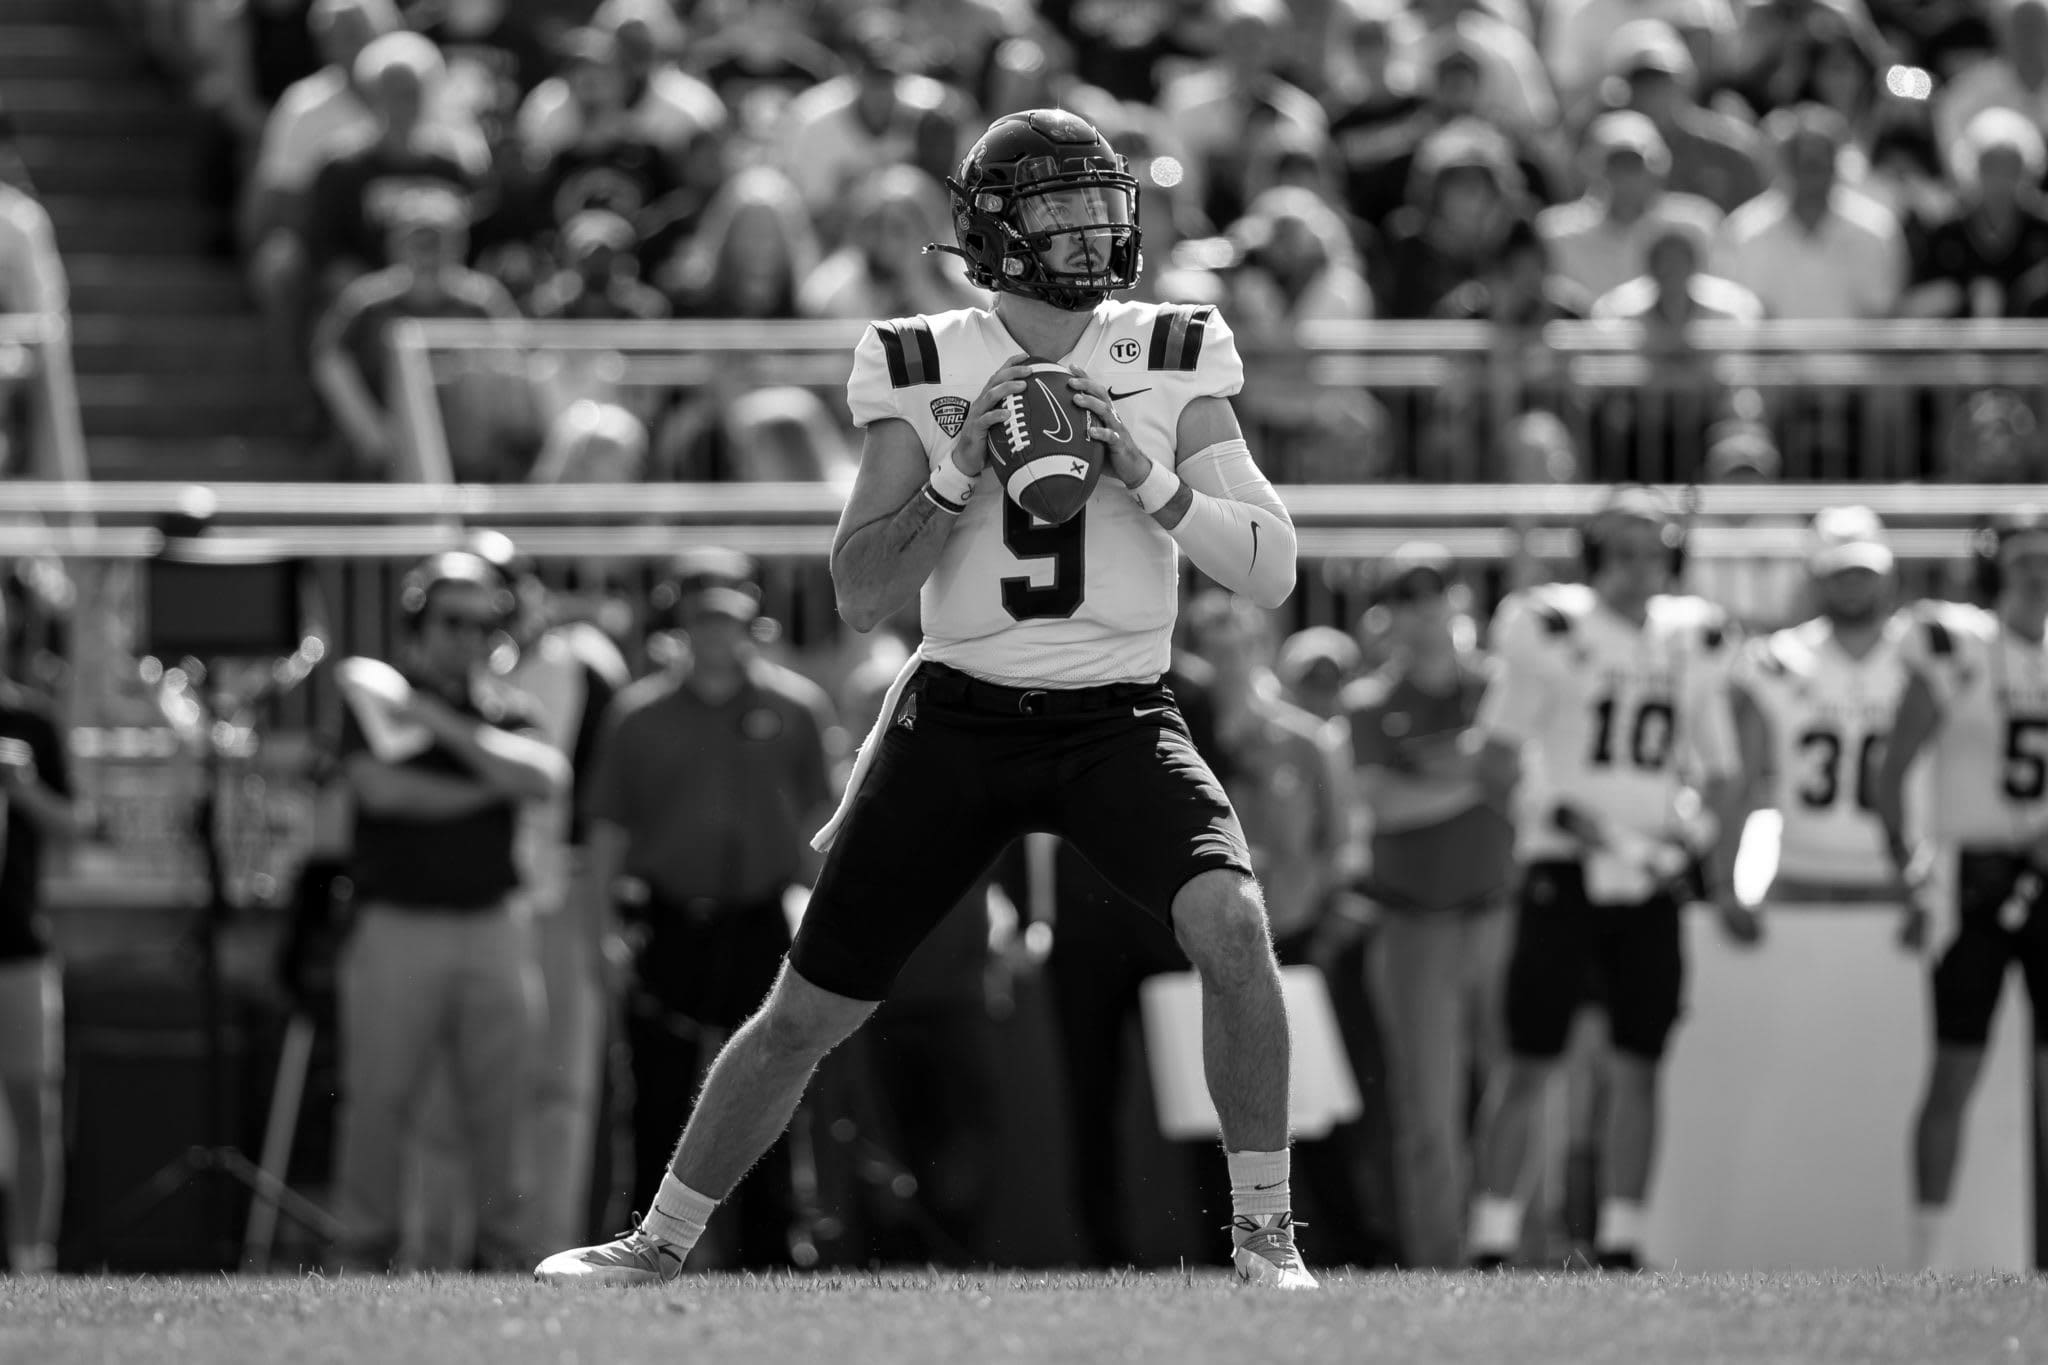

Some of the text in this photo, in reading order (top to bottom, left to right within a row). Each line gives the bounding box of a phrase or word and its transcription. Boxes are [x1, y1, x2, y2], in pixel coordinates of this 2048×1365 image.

[1114, 343, 1137, 358] TC
[936, 414, 965, 425] MAC
[1000, 487, 1086, 622] 9
[1593, 697, 1676, 771] 10
[2003, 716, 2048, 801] 5
